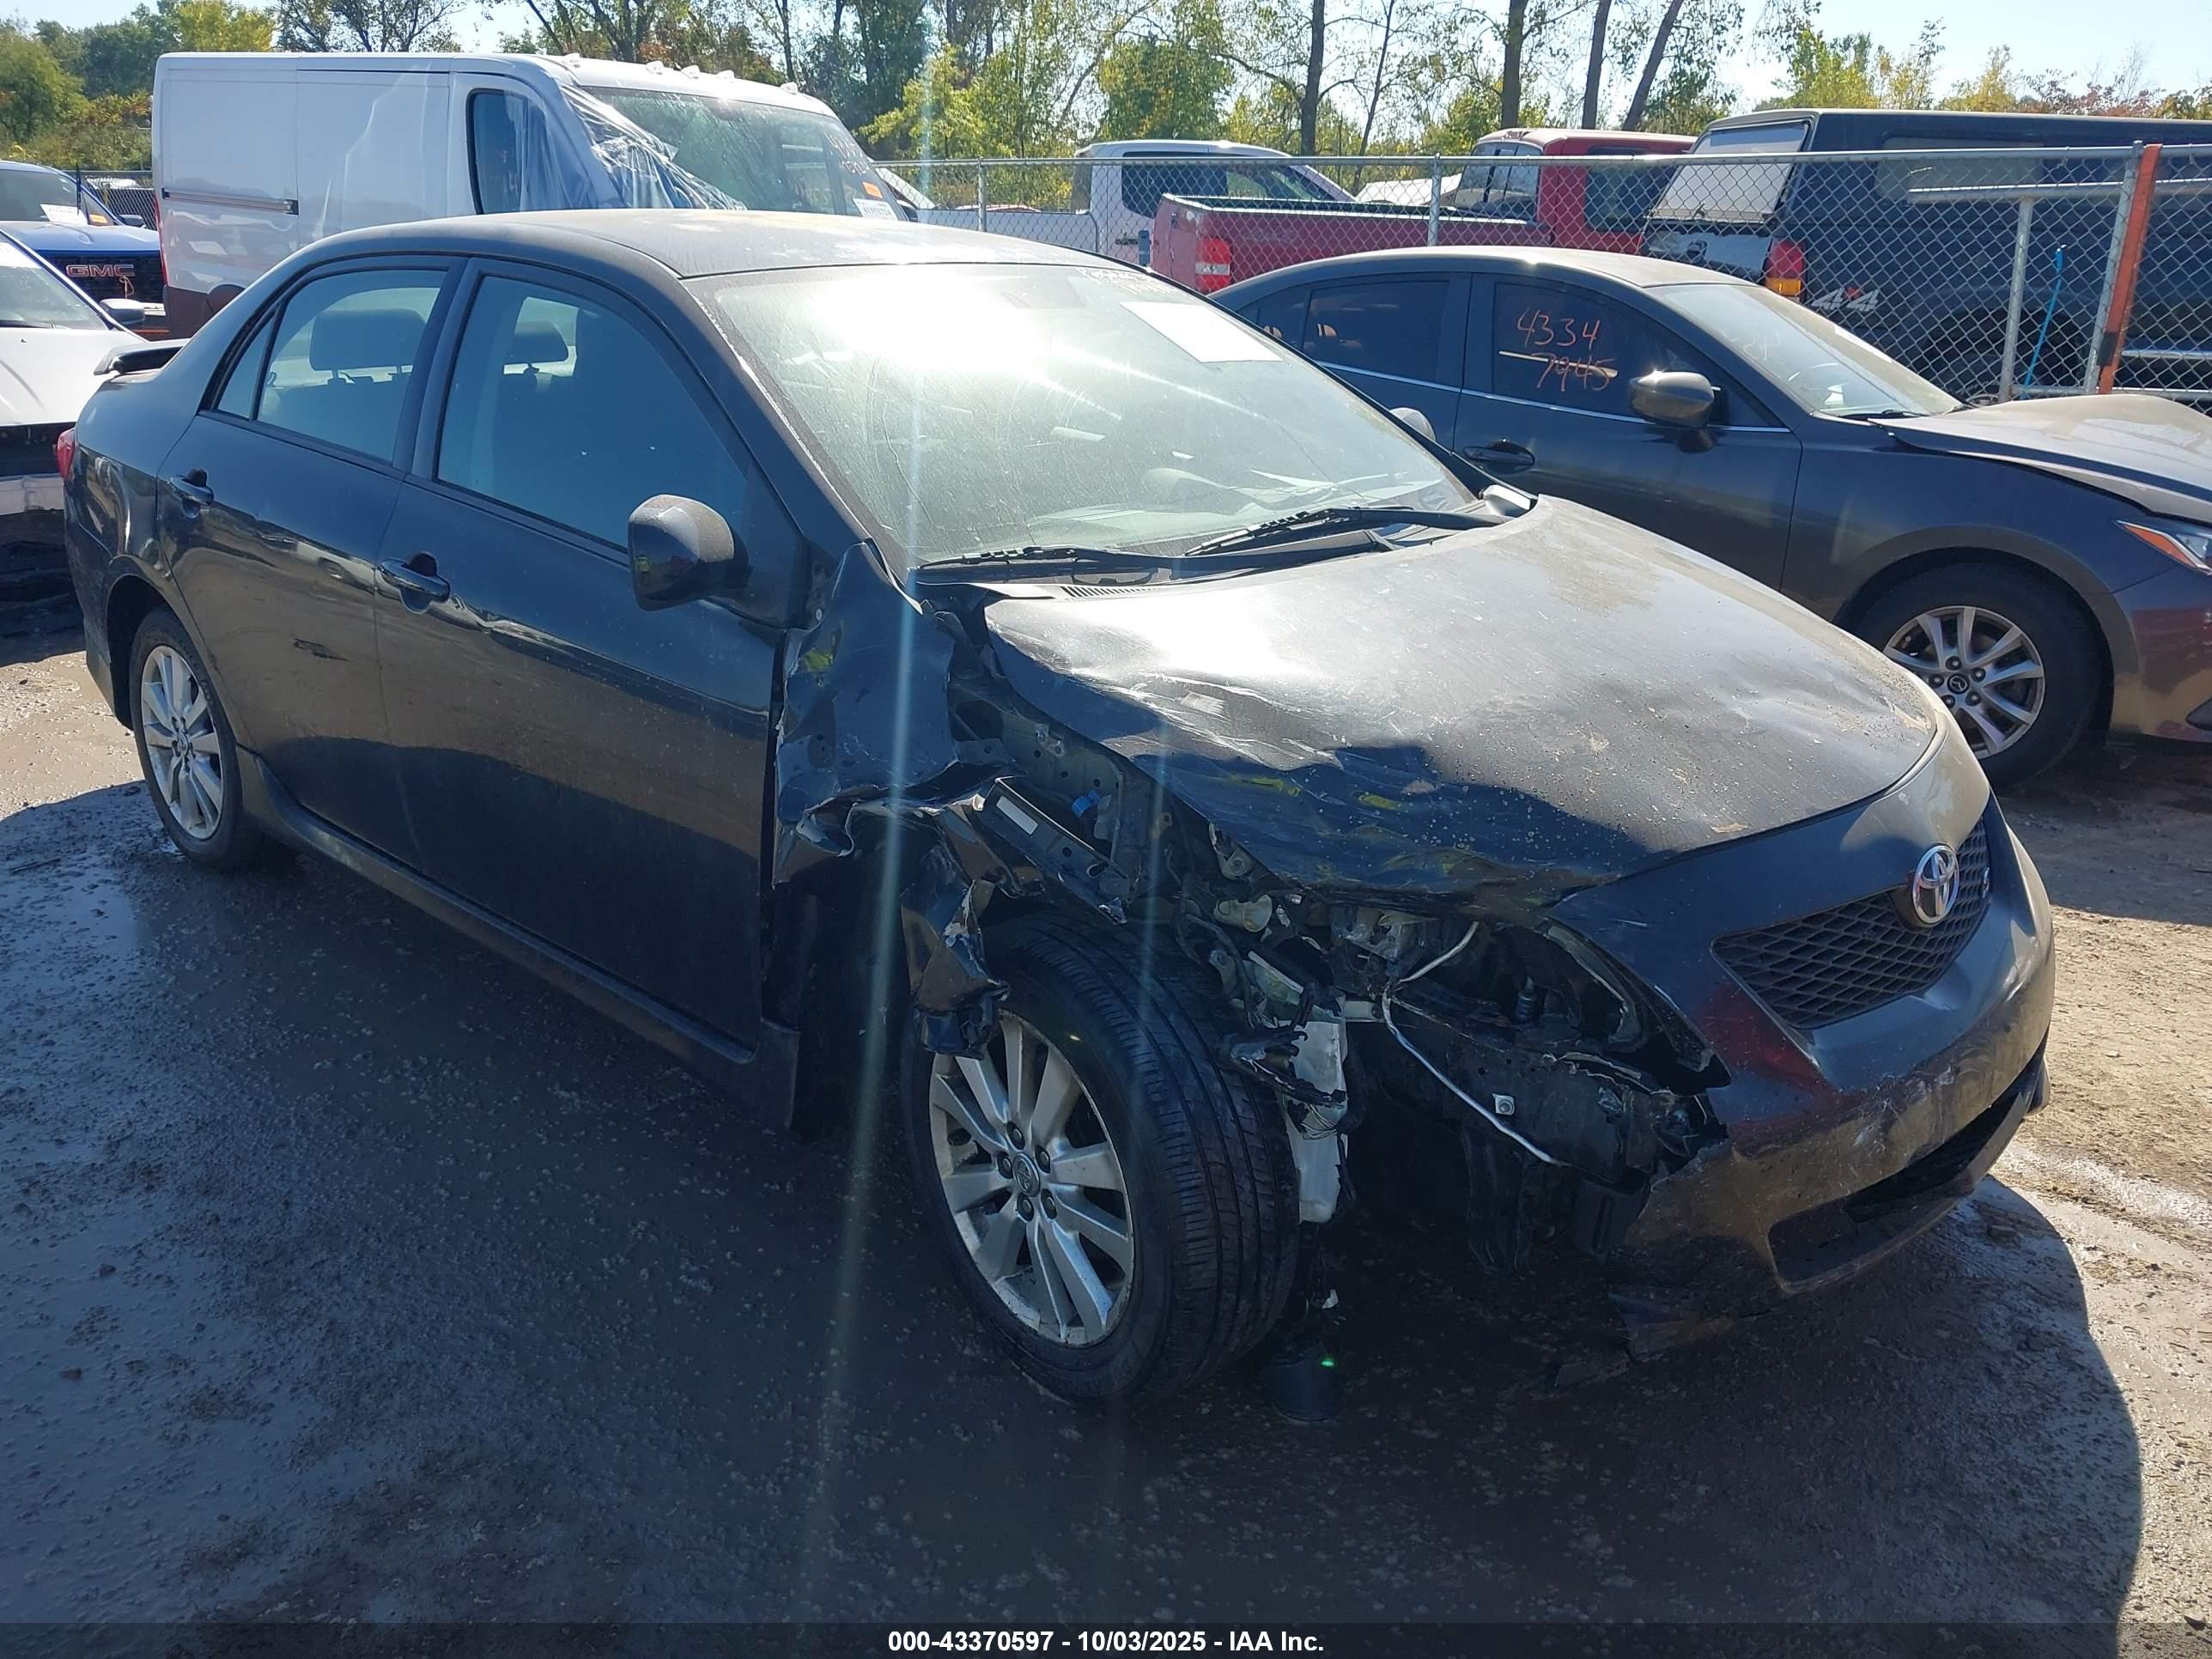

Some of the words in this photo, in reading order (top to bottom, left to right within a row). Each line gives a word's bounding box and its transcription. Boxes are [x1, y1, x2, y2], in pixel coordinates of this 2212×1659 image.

[66, 264, 136, 277] GMC
[1517, 308, 1600, 350] 4334
[1531, 352, 1616, 392] 7945
